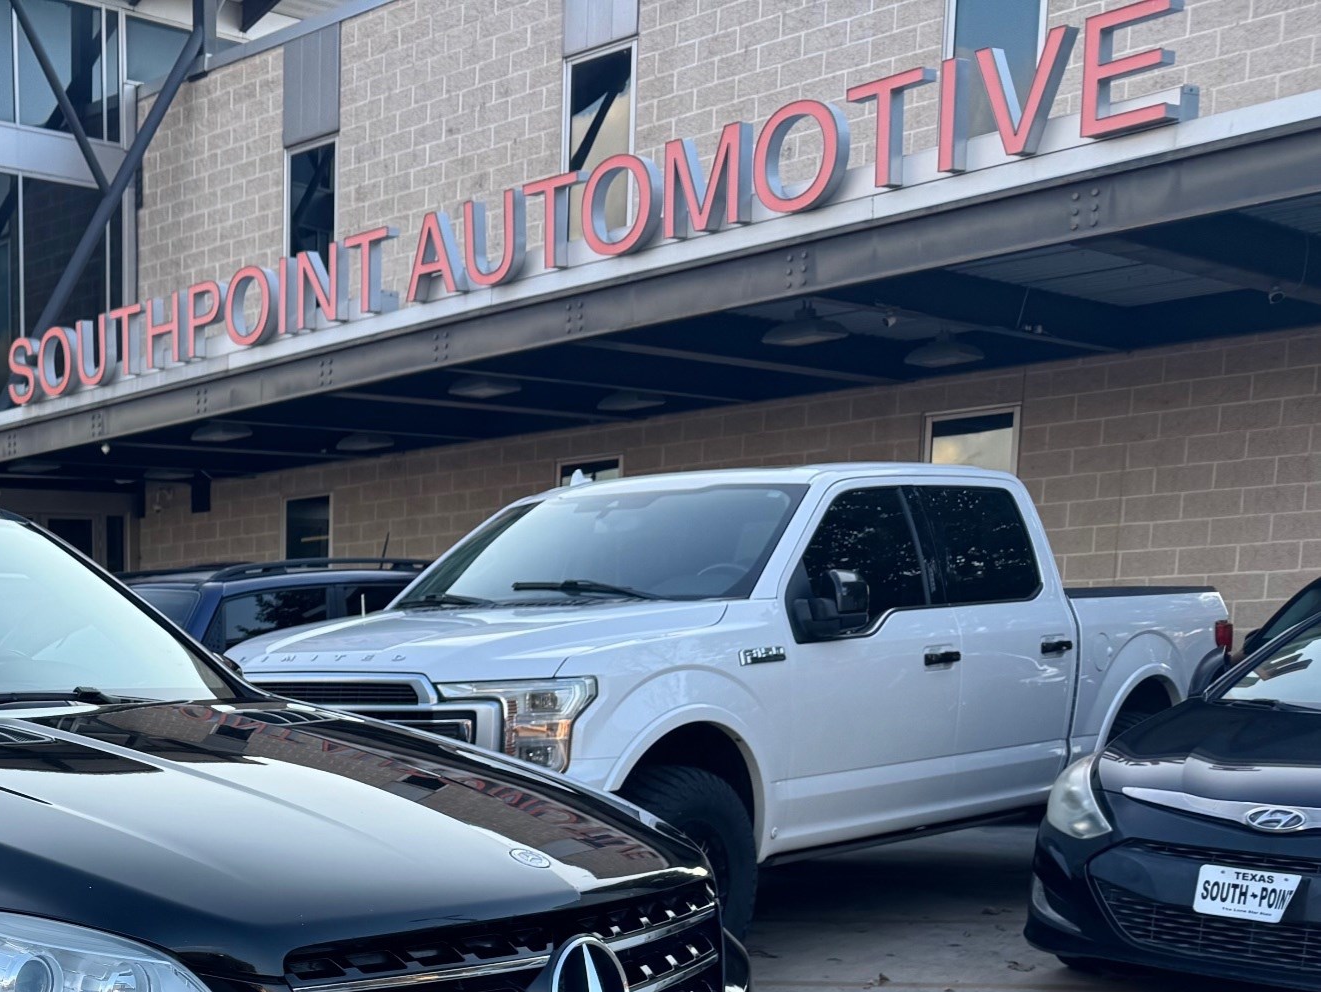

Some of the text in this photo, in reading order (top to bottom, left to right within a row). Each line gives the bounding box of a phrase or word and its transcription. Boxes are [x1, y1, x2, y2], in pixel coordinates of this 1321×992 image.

[8, 0, 1185, 405] SOUTHPOINT AUTOMOTIVE
[239, 654, 408, 664] LIMITED
[1234, 871, 1275, 884] TEXAS
[1201, 880, 1295, 911] SOUTH POINT
